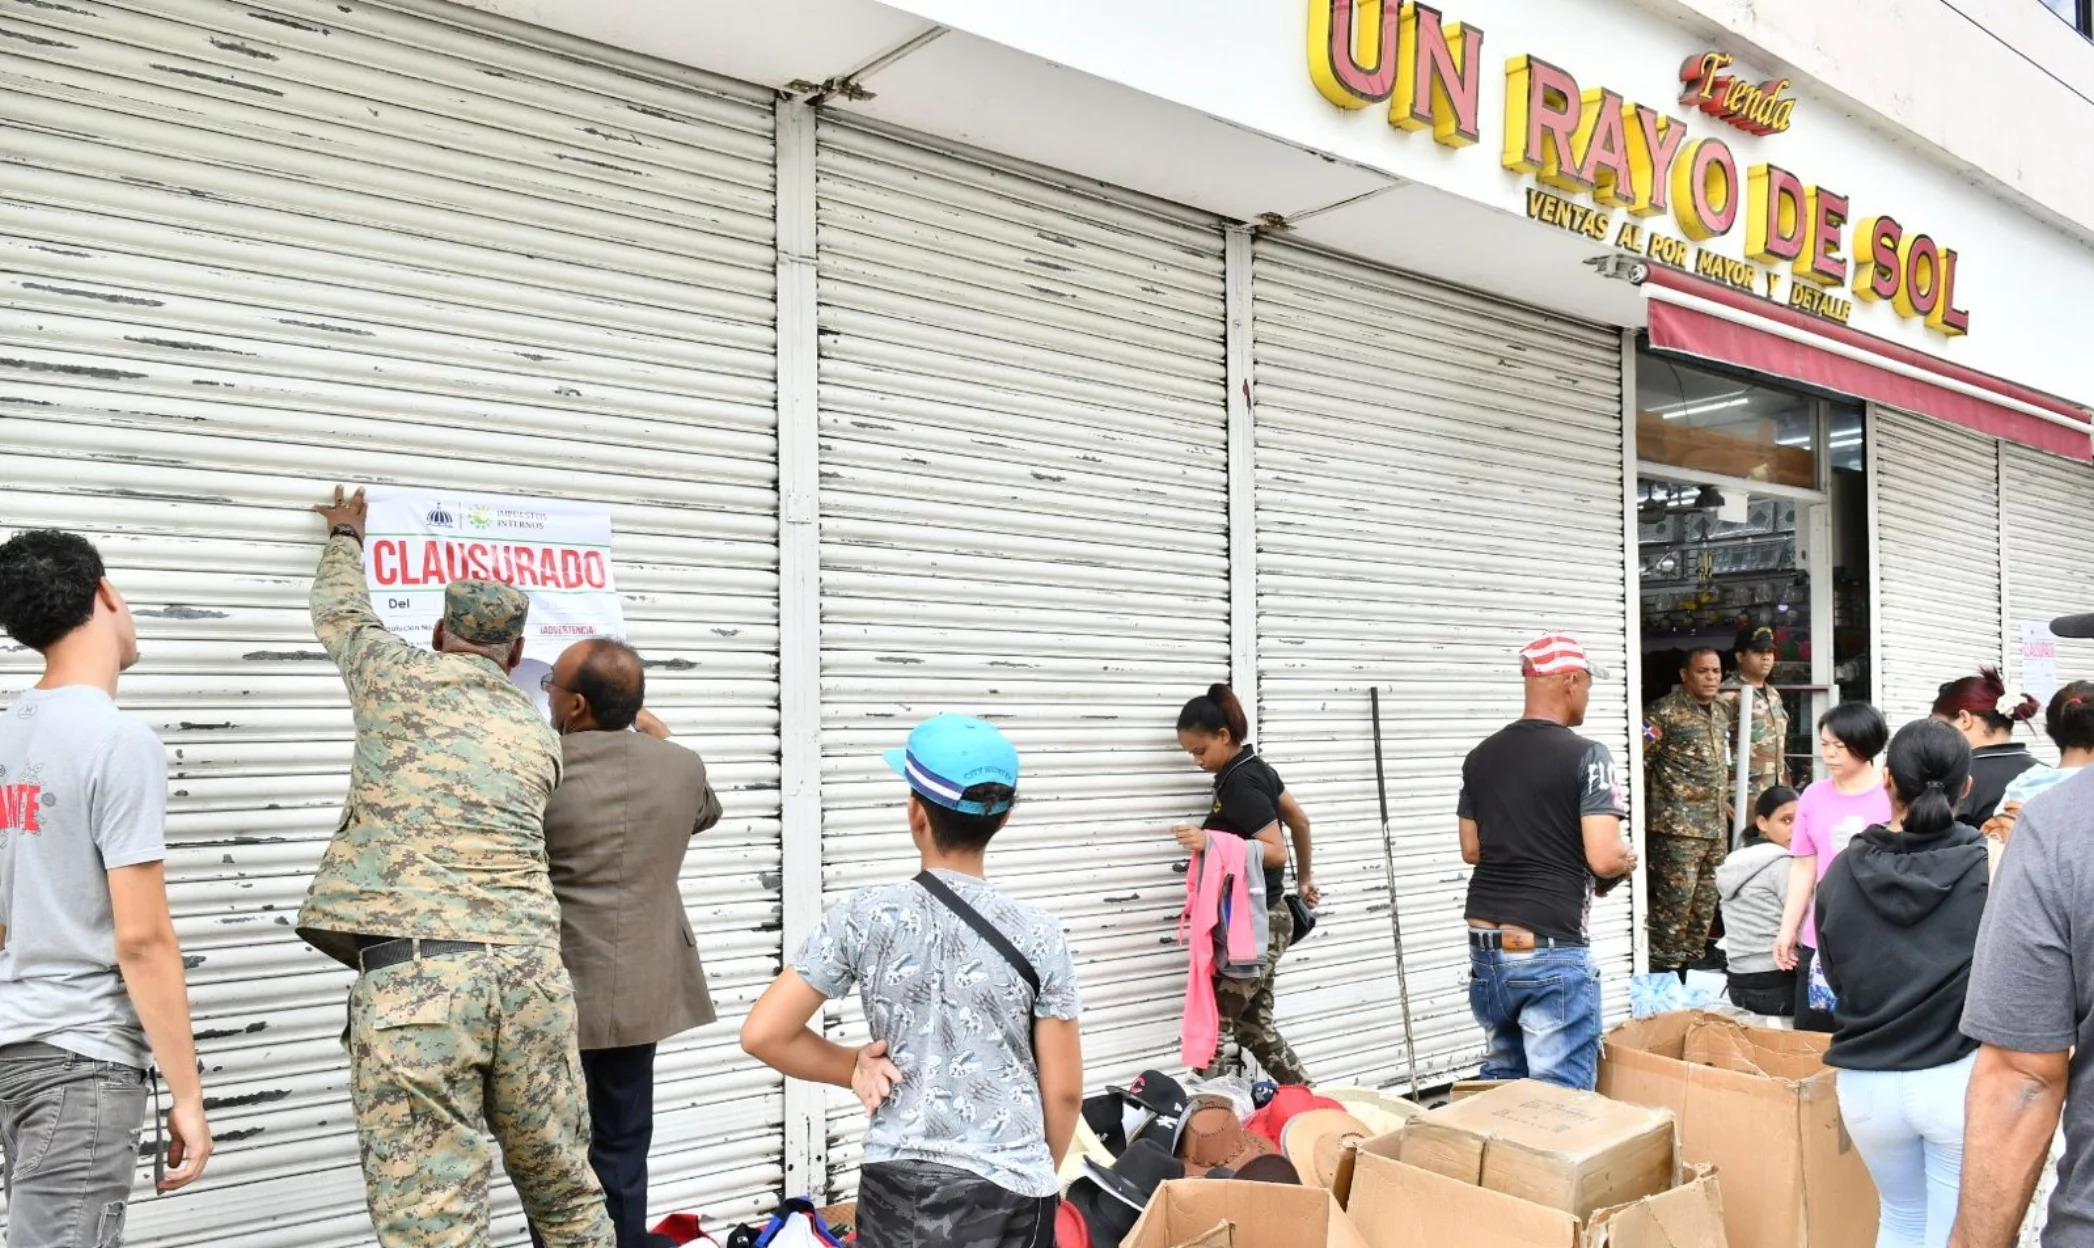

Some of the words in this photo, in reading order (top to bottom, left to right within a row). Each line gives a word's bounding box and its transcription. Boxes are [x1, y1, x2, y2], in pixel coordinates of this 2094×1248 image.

[1692, 51, 1796, 133] Tienda
[1315, 0, 1484, 146] UN
[1508, 54, 1738, 240] RAYO
[1752, 163, 1848, 287] DE
[1858, 216, 1968, 335] SOL
[1527, 187, 1609, 241] VENTAS
[1615, 222, 1643, 253] AL
[1648, 232, 1688, 269] POR
[1696, 248, 1757, 292] MAYOR
[1766, 272, 1781, 299] Y
[1789, 281, 1852, 325] DETALLE
[497, 509, 548, 519] IMPUESTOS
[497, 519, 544, 530] INTERNOS
[373, 540, 606, 589] CLAUSURADO
[388, 598, 410, 609] Del
